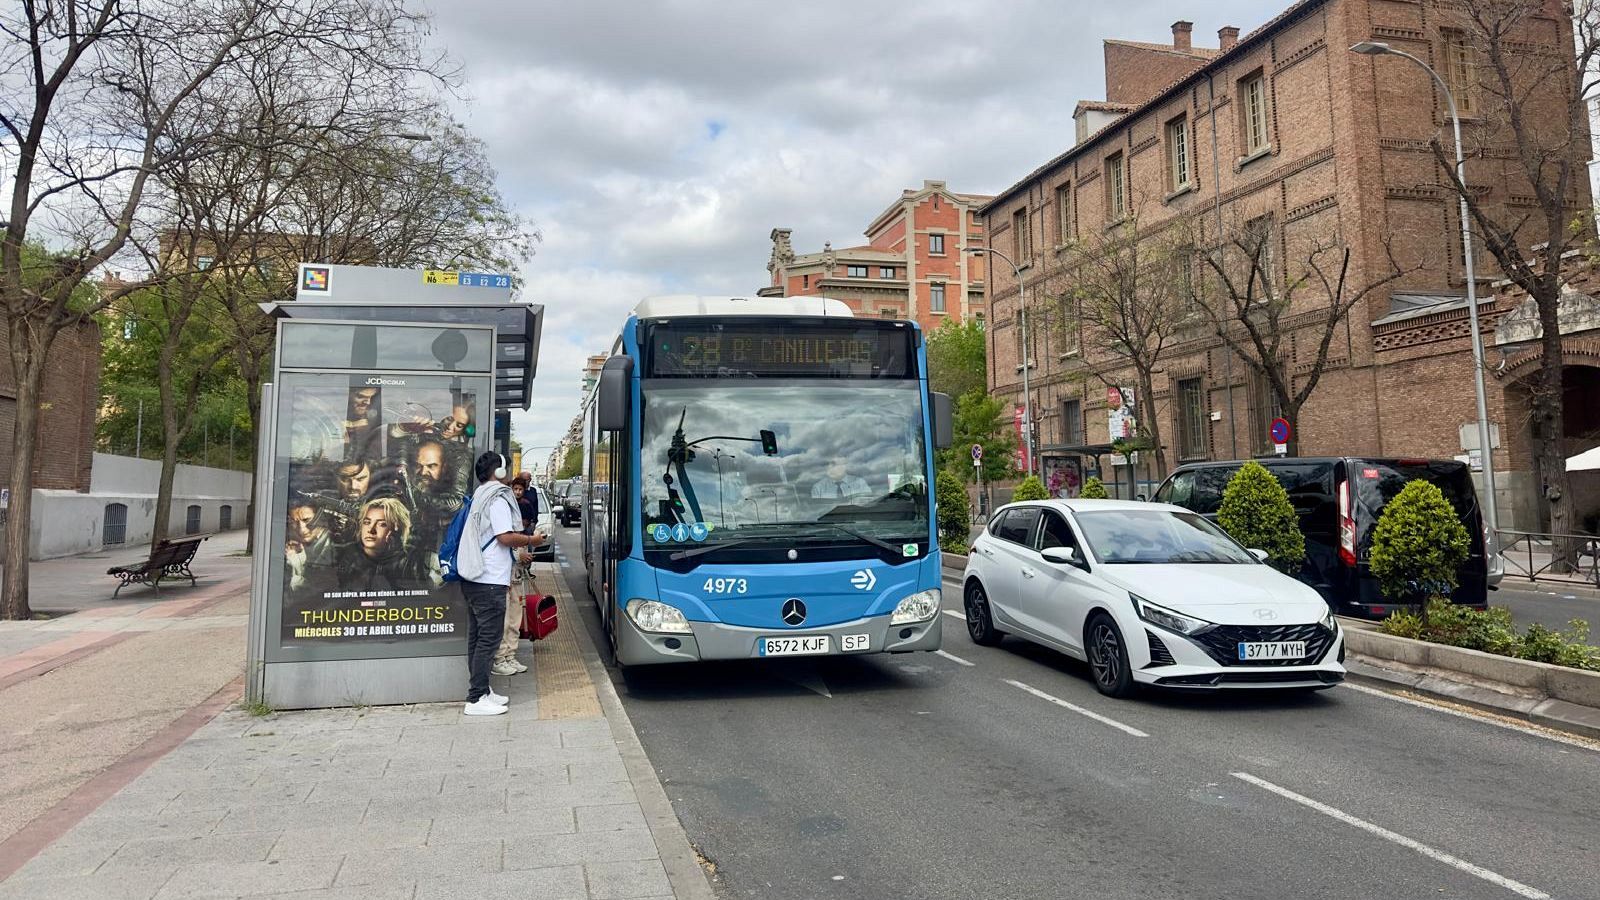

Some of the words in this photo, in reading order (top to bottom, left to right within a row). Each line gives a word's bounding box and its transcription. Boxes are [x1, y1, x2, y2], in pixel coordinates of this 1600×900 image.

[496, 277, 507, 286] 28
[365, 378, 406, 386] JCDecaux
[703, 578, 748, 594] 4973
[294, 626, 342, 638] MIÉRCOLES
[343, 626, 355, 636] 30
[356, 626, 368, 636] DE
[369, 625, 394, 635] ABRIL
[395, 624, 417, 634] SOLO
[418, 624, 429, 633] EN
[430, 623, 455, 633] CINES
[767, 640, 798, 653] 6572
[802, 639, 825, 651] KJF
[1247, 643, 1278, 657] 3717
[1281, 643, 1303, 656] MYH
